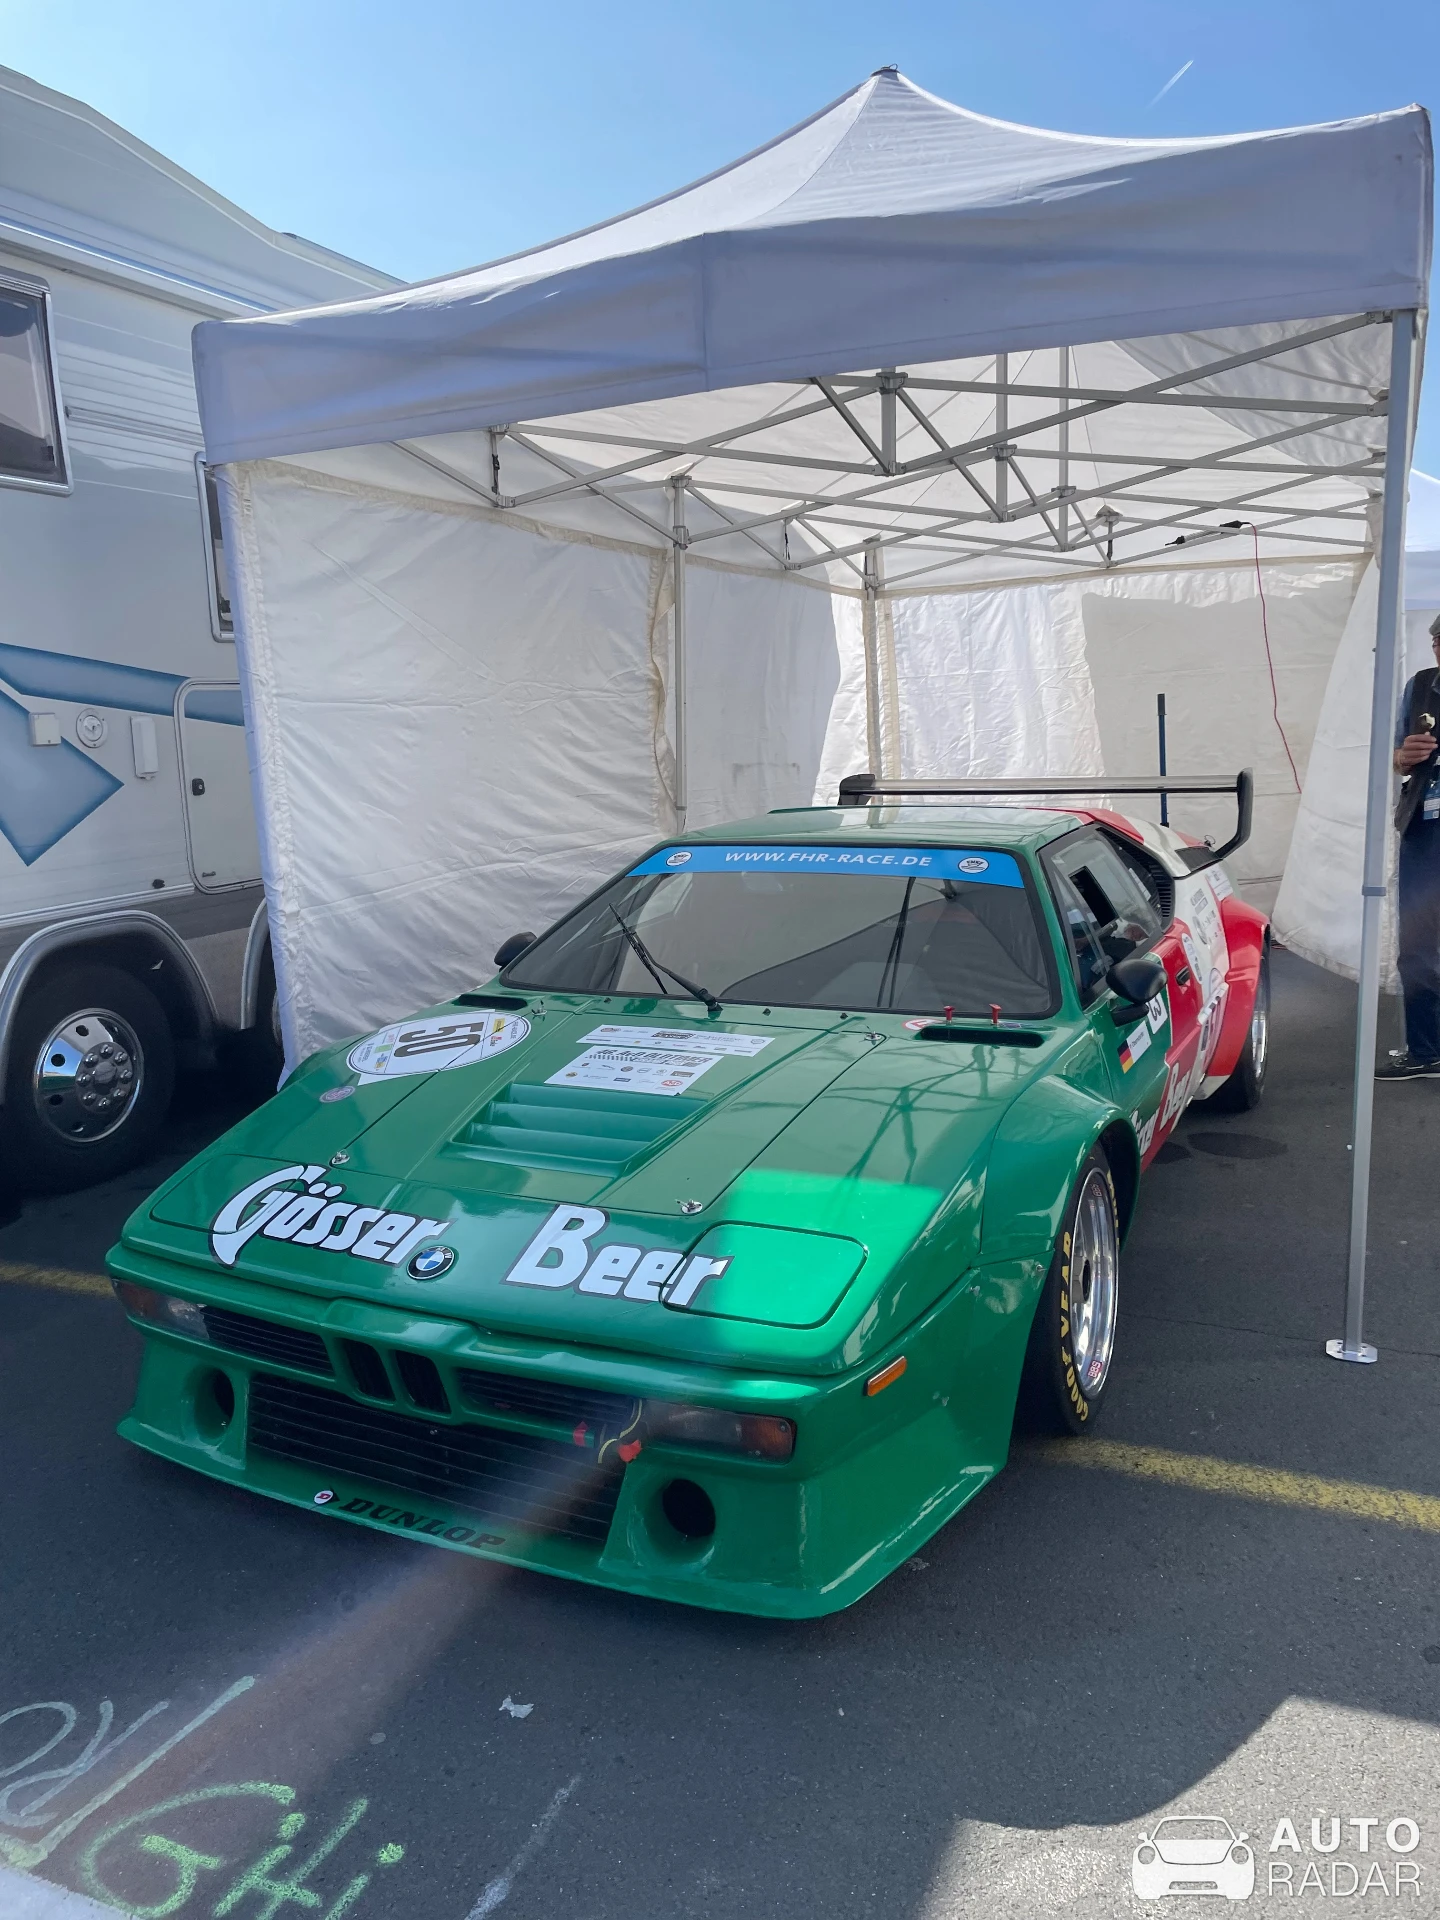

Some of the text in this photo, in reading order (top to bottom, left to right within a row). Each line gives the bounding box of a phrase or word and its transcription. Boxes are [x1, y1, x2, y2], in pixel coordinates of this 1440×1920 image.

[725, 852, 932, 867] WWW.FHR-RACE.DE
[210, 1164, 730, 1306] Gösser Beer
[338, 1497, 507, 1549] DUNLOP
